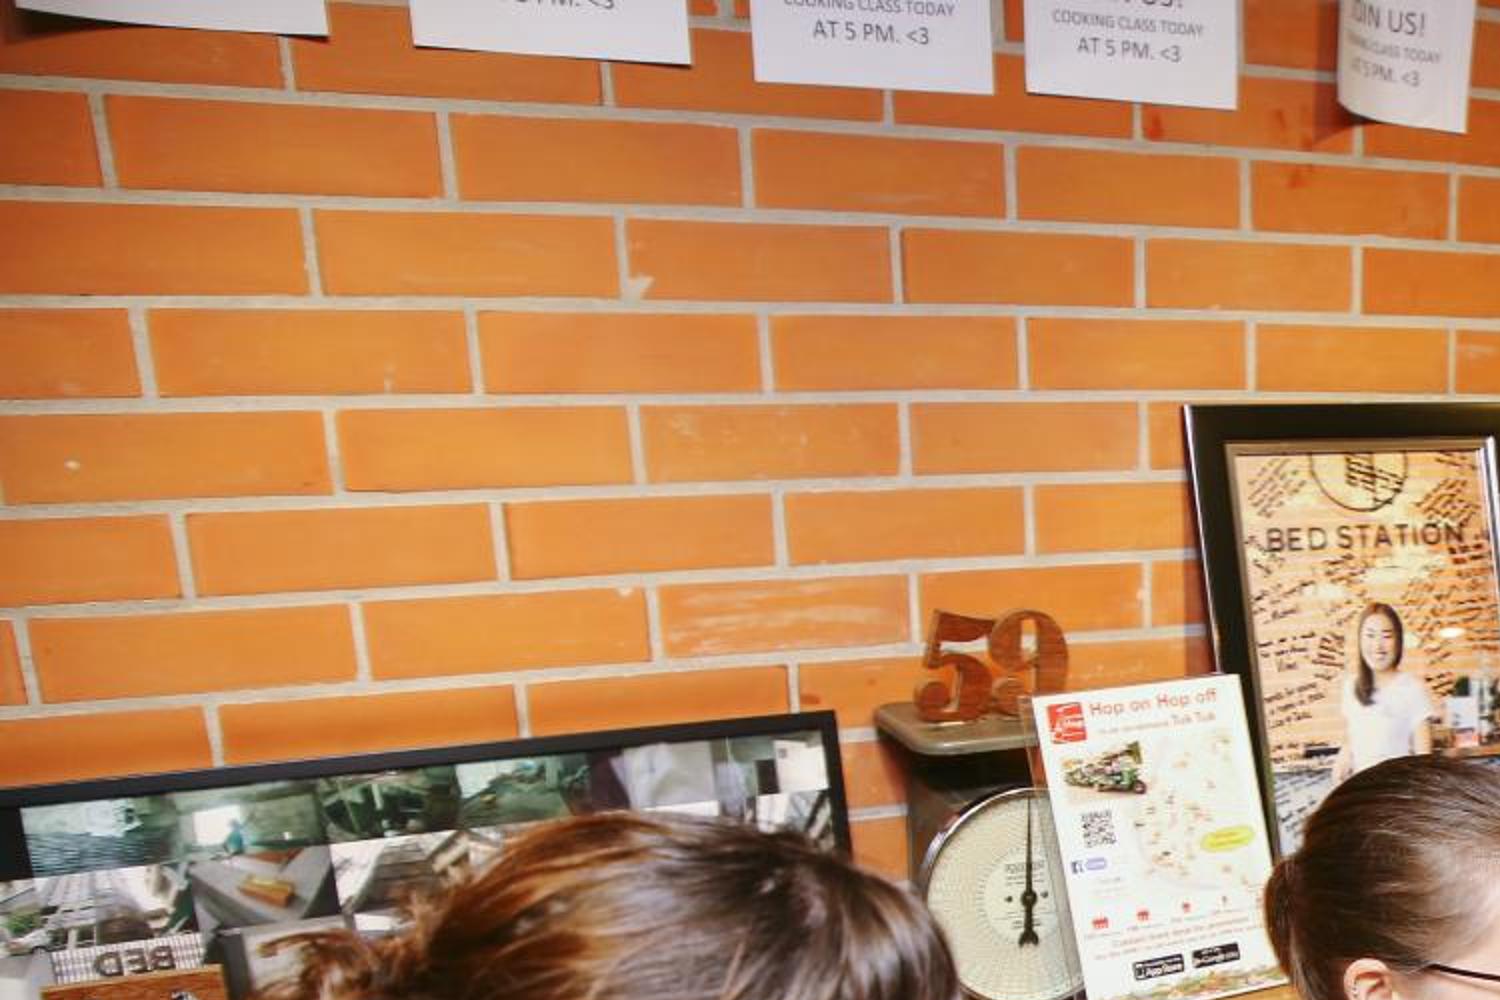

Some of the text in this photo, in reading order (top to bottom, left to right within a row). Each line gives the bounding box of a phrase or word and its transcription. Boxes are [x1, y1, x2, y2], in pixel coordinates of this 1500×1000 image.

[858, 0, 900, 13] CLASS
[906, 1, 956, 16] TODAY
[813, 19, 929, 45] AT 5 PM. <3
[1053, 9, 1203, 37] COOKING CLASS TODAY
[1388, 8, 1426, 38] US!
[1077, 37, 1181, 63] AT 5 PM. <3
[1266, 523, 1466, 551] BED STATION
[914, 609, 1068, 723] 59
[1089, 688, 1217, 716] Hop on Hop off
